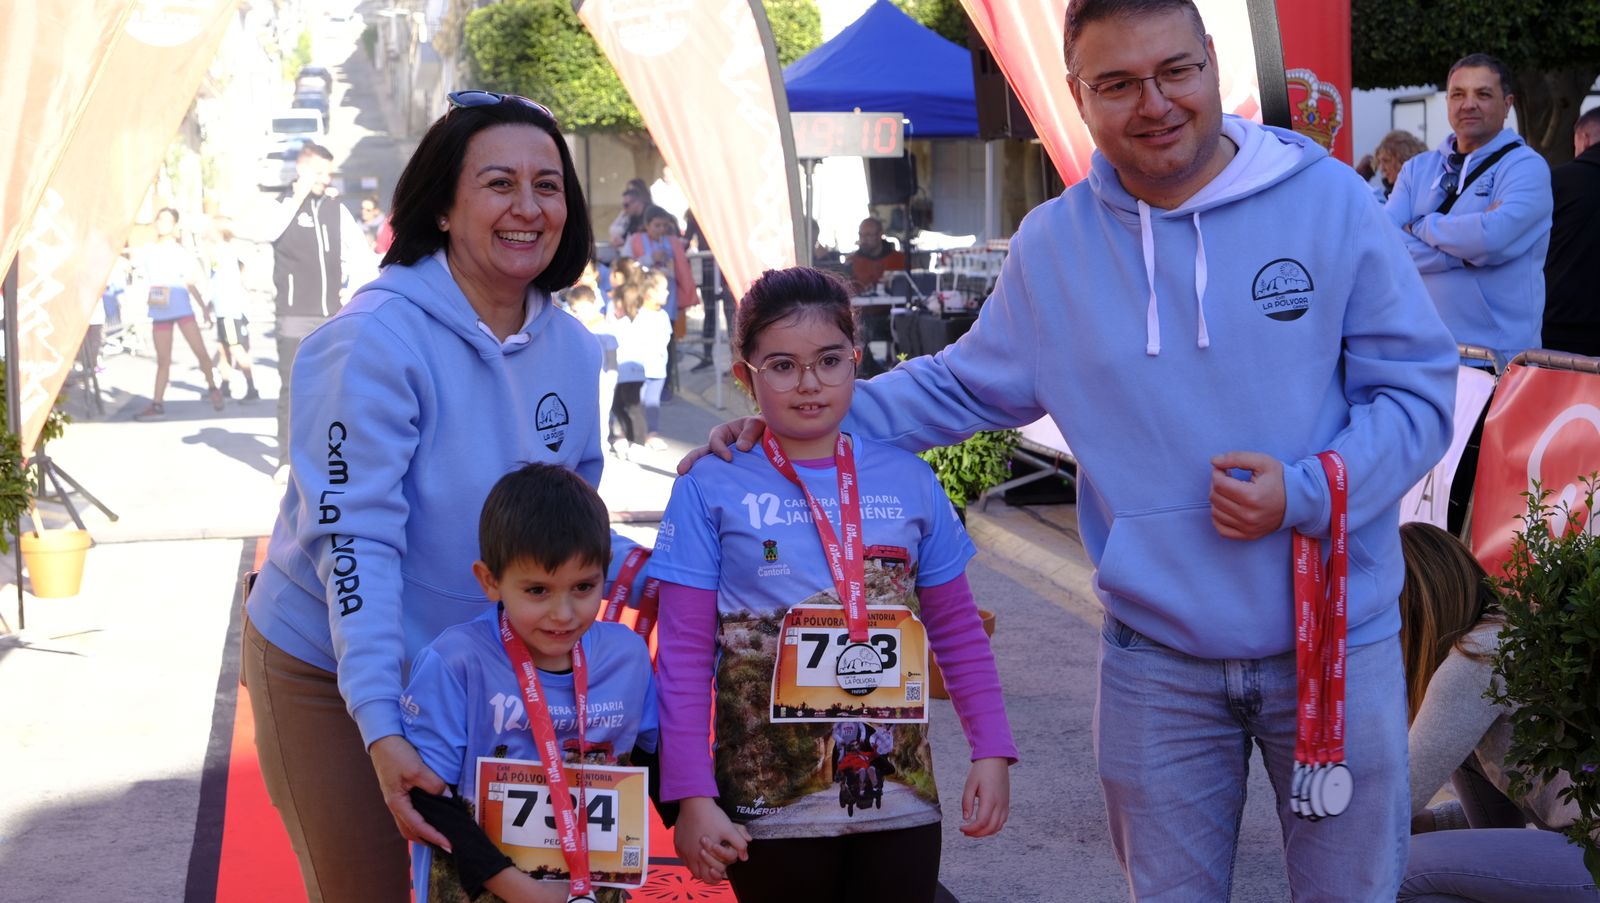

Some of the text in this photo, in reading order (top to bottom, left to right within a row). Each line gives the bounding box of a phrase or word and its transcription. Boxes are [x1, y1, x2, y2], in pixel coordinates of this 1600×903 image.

[319, 491, 344, 524] LA
[742, 492, 785, 530] 12
[791, 617, 801, 626] LA
[801, 632, 898, 669] 73
[489, 692, 524, 735] 12
[496, 772, 508, 781] LA
